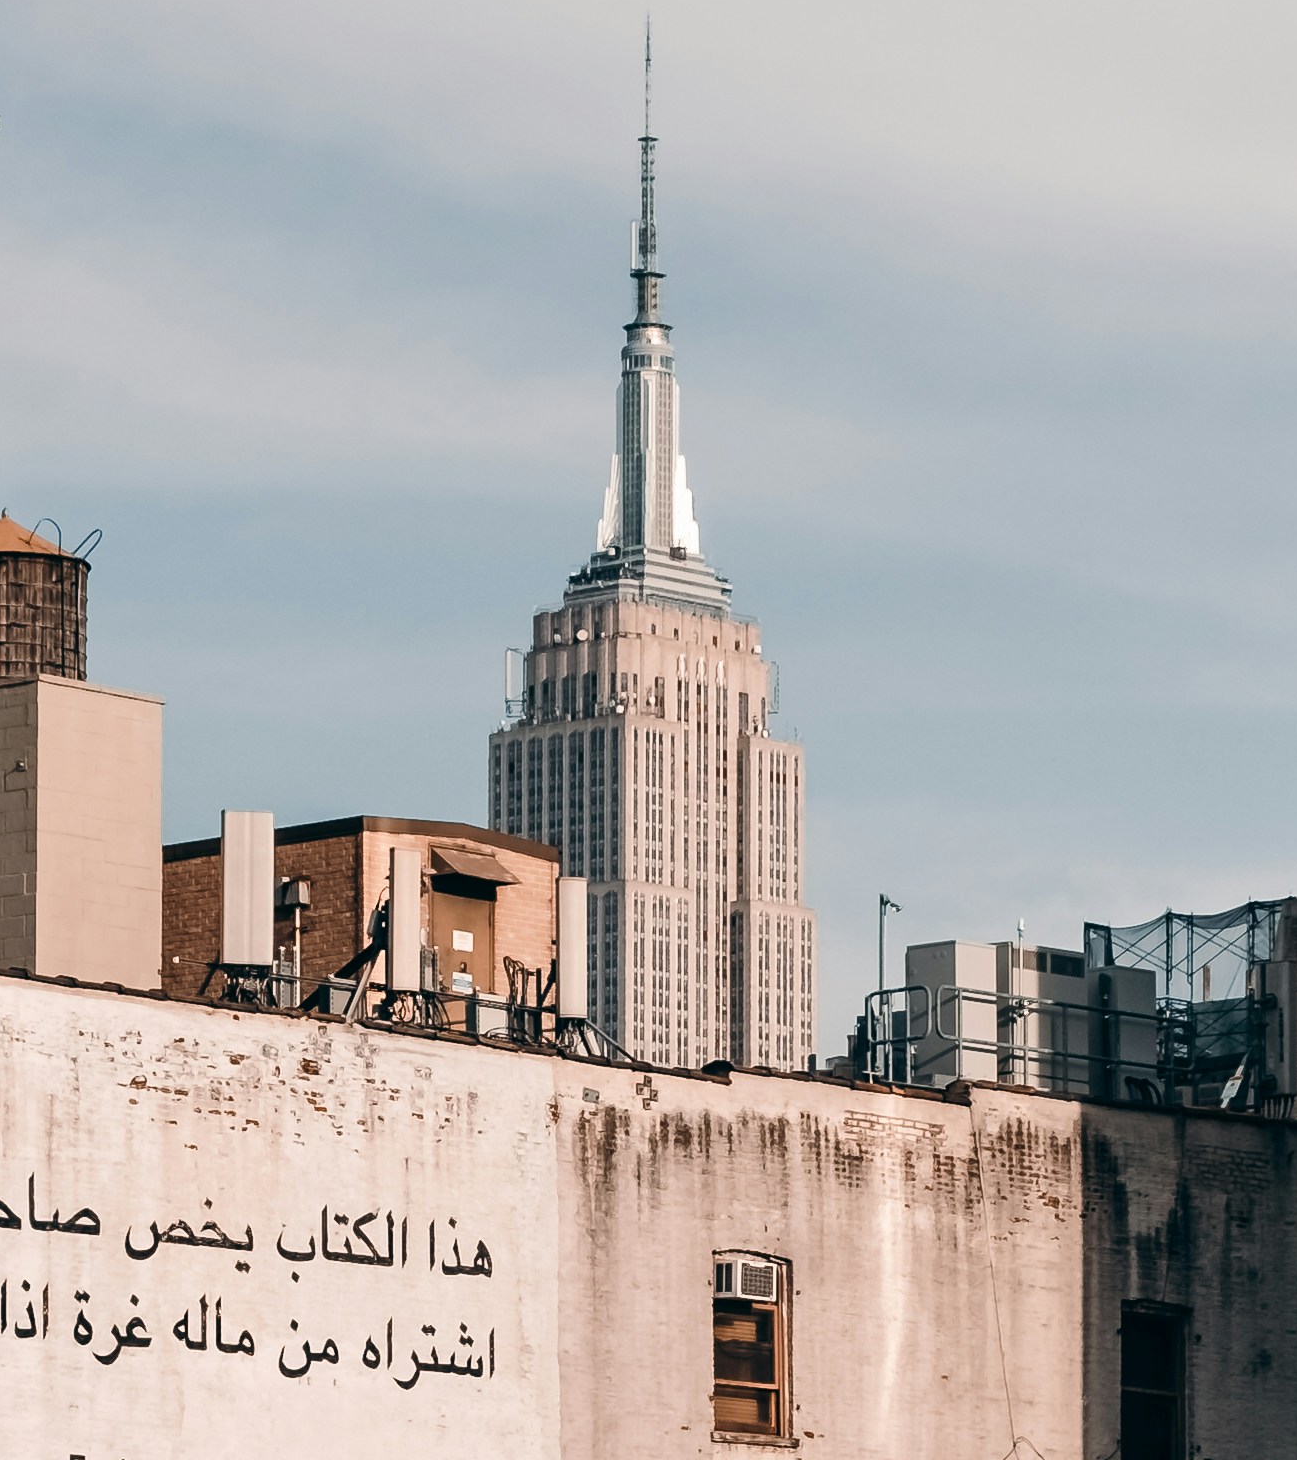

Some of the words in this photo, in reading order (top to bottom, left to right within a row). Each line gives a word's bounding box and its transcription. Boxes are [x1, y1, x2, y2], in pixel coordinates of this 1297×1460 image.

[124, 1198, 254, 1274] يخص
[276, 1205, 408, 1284] الكتاب
[429, 1217, 493, 1278] هذا
[73, 1289, 153, 1366] غرة
[172, 1294, 255, 1357] ماله
[278, 1319, 340, 1379] من
[362, 1317, 495, 1391] اشتراه
